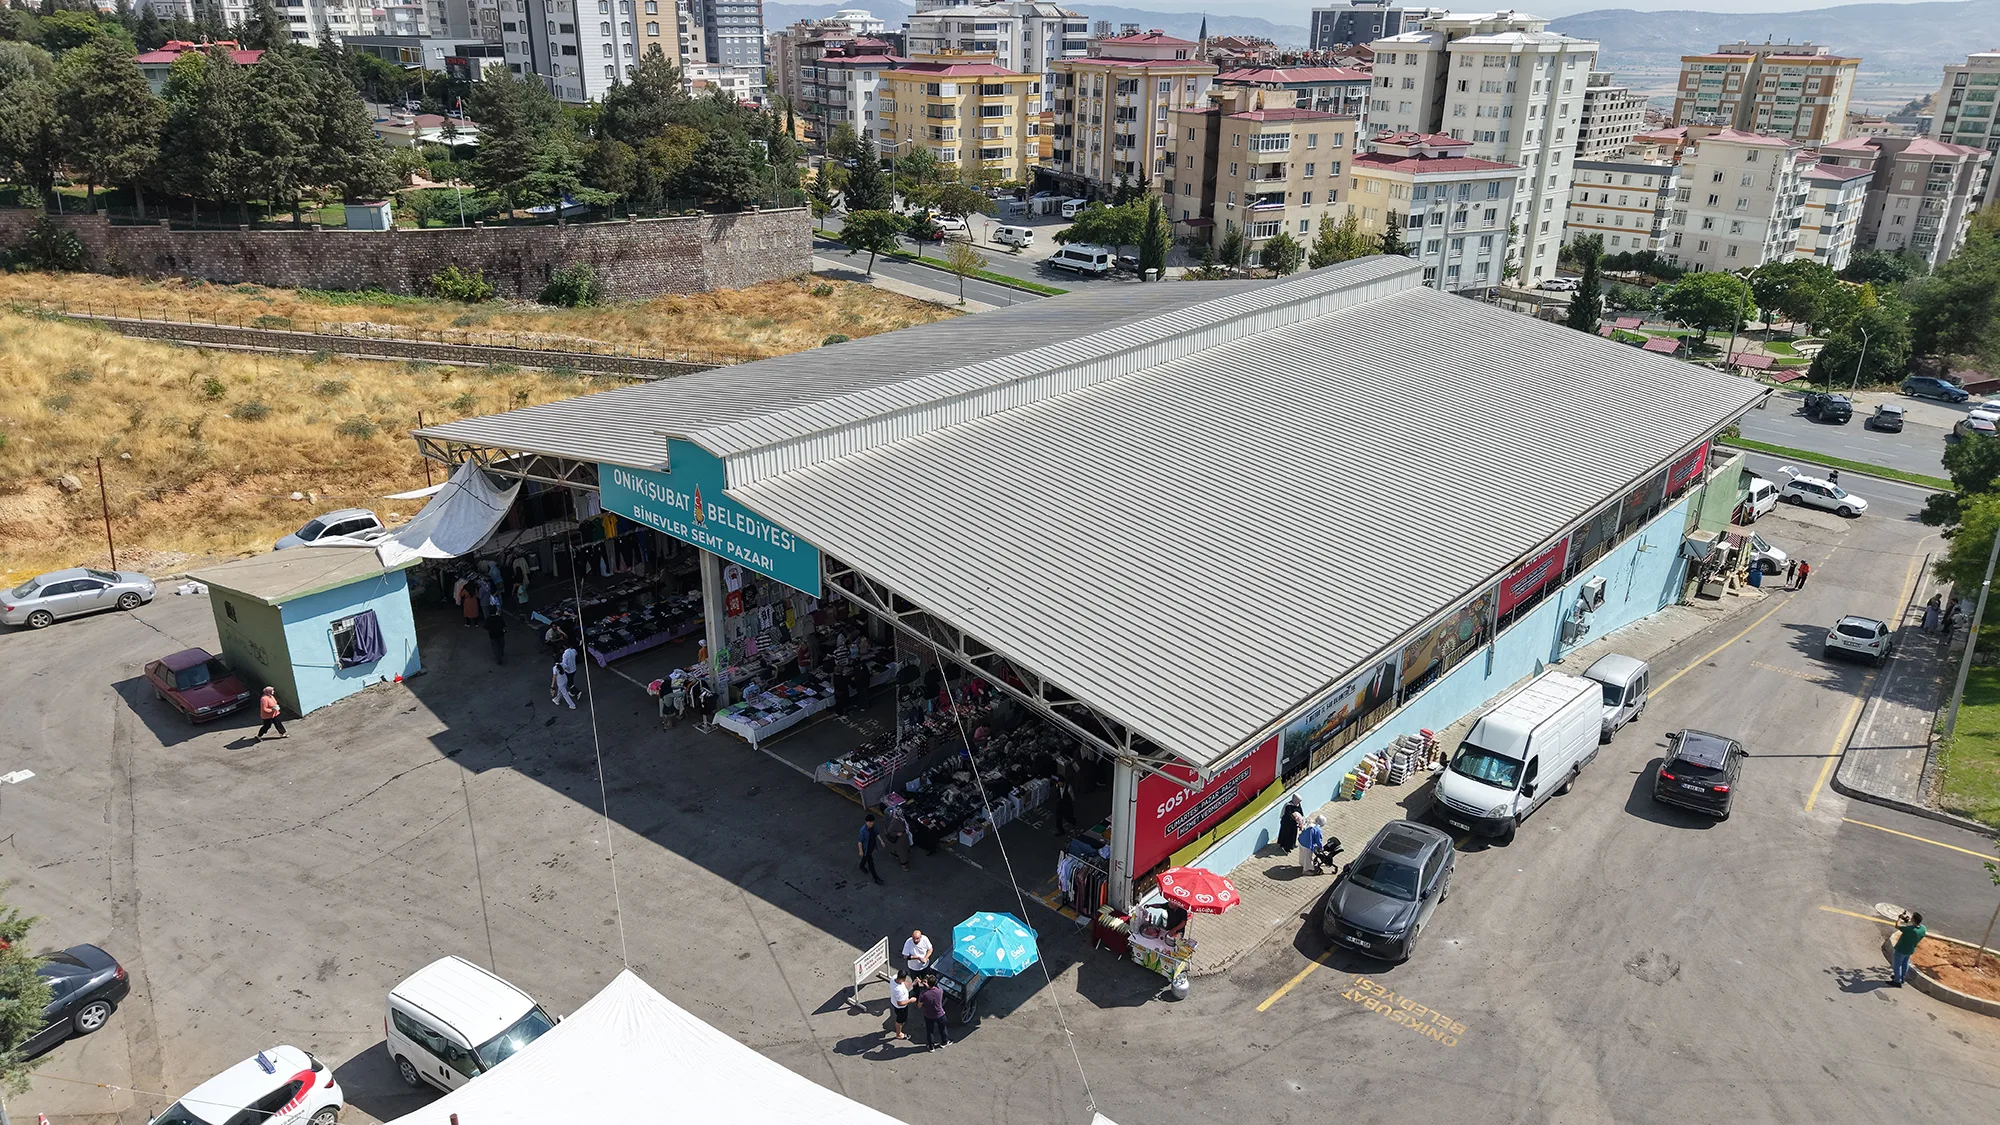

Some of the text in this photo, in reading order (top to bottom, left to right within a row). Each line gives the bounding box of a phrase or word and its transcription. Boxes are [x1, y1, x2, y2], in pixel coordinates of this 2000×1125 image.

[613, 468, 796, 553] ONİKİŞUBAT BELEDİYESİ
[633, 505, 774, 571] BİNEVLER SEMT PAZARI
